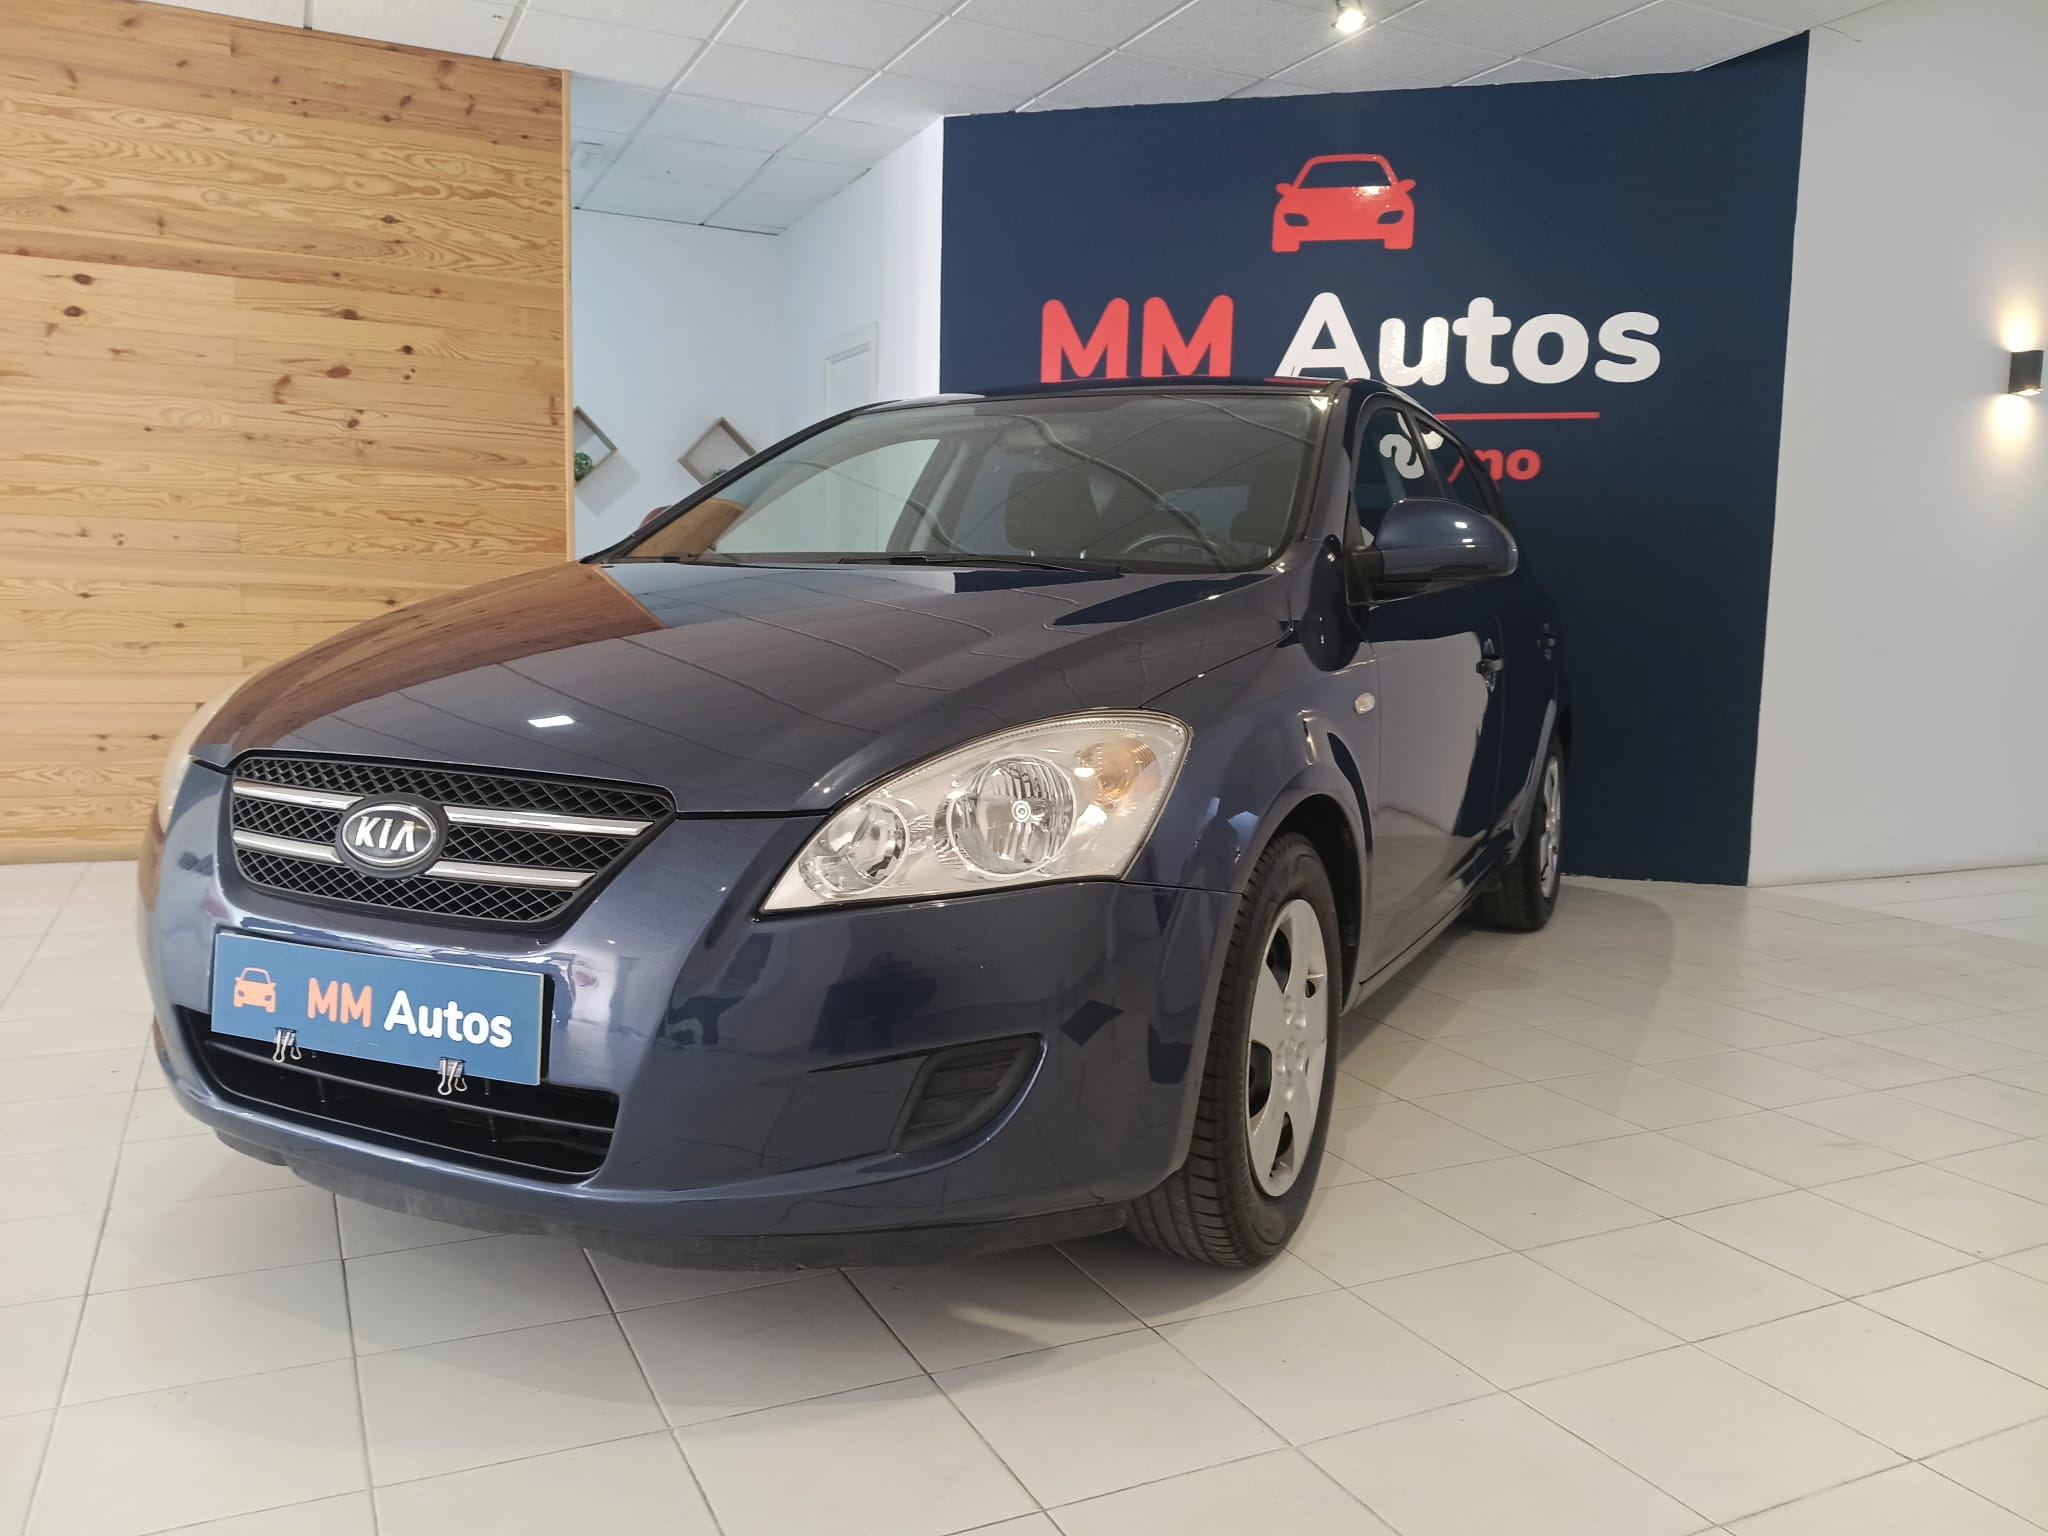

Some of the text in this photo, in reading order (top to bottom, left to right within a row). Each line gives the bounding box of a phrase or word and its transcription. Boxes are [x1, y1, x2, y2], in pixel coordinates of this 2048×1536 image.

[1041, 292, 1660, 386] MM Autos
[354, 816, 417, 852] KIA
[308, 978, 512, 1048] MM Autos
